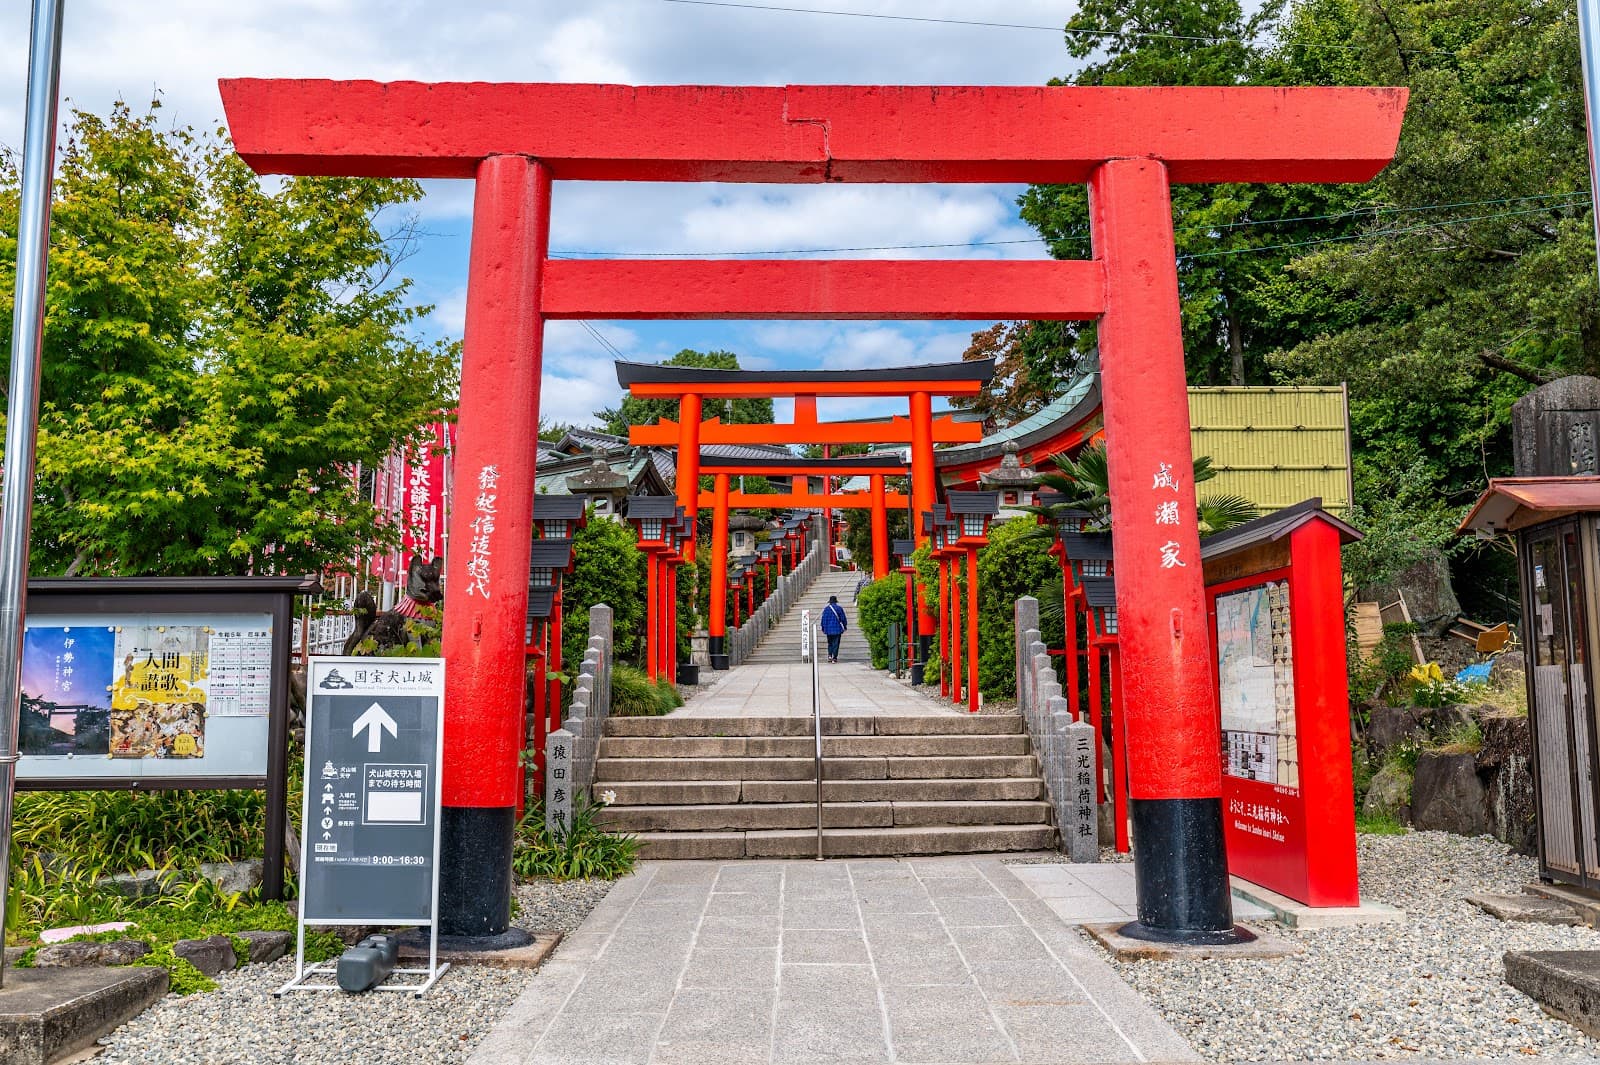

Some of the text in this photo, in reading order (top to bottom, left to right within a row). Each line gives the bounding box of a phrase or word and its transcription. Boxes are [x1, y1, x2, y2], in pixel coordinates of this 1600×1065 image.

[61, 637, 76, 692] 伊勢神宮
[143, 652, 180, 669] 人間
[354, 669, 433, 685] 国宝犬山城
[368, 769, 422, 778] 犬山城天守入場
[368, 779, 422, 788] までの待ち時間
[1077, 738, 1093, 838] 三光稲荷神社
